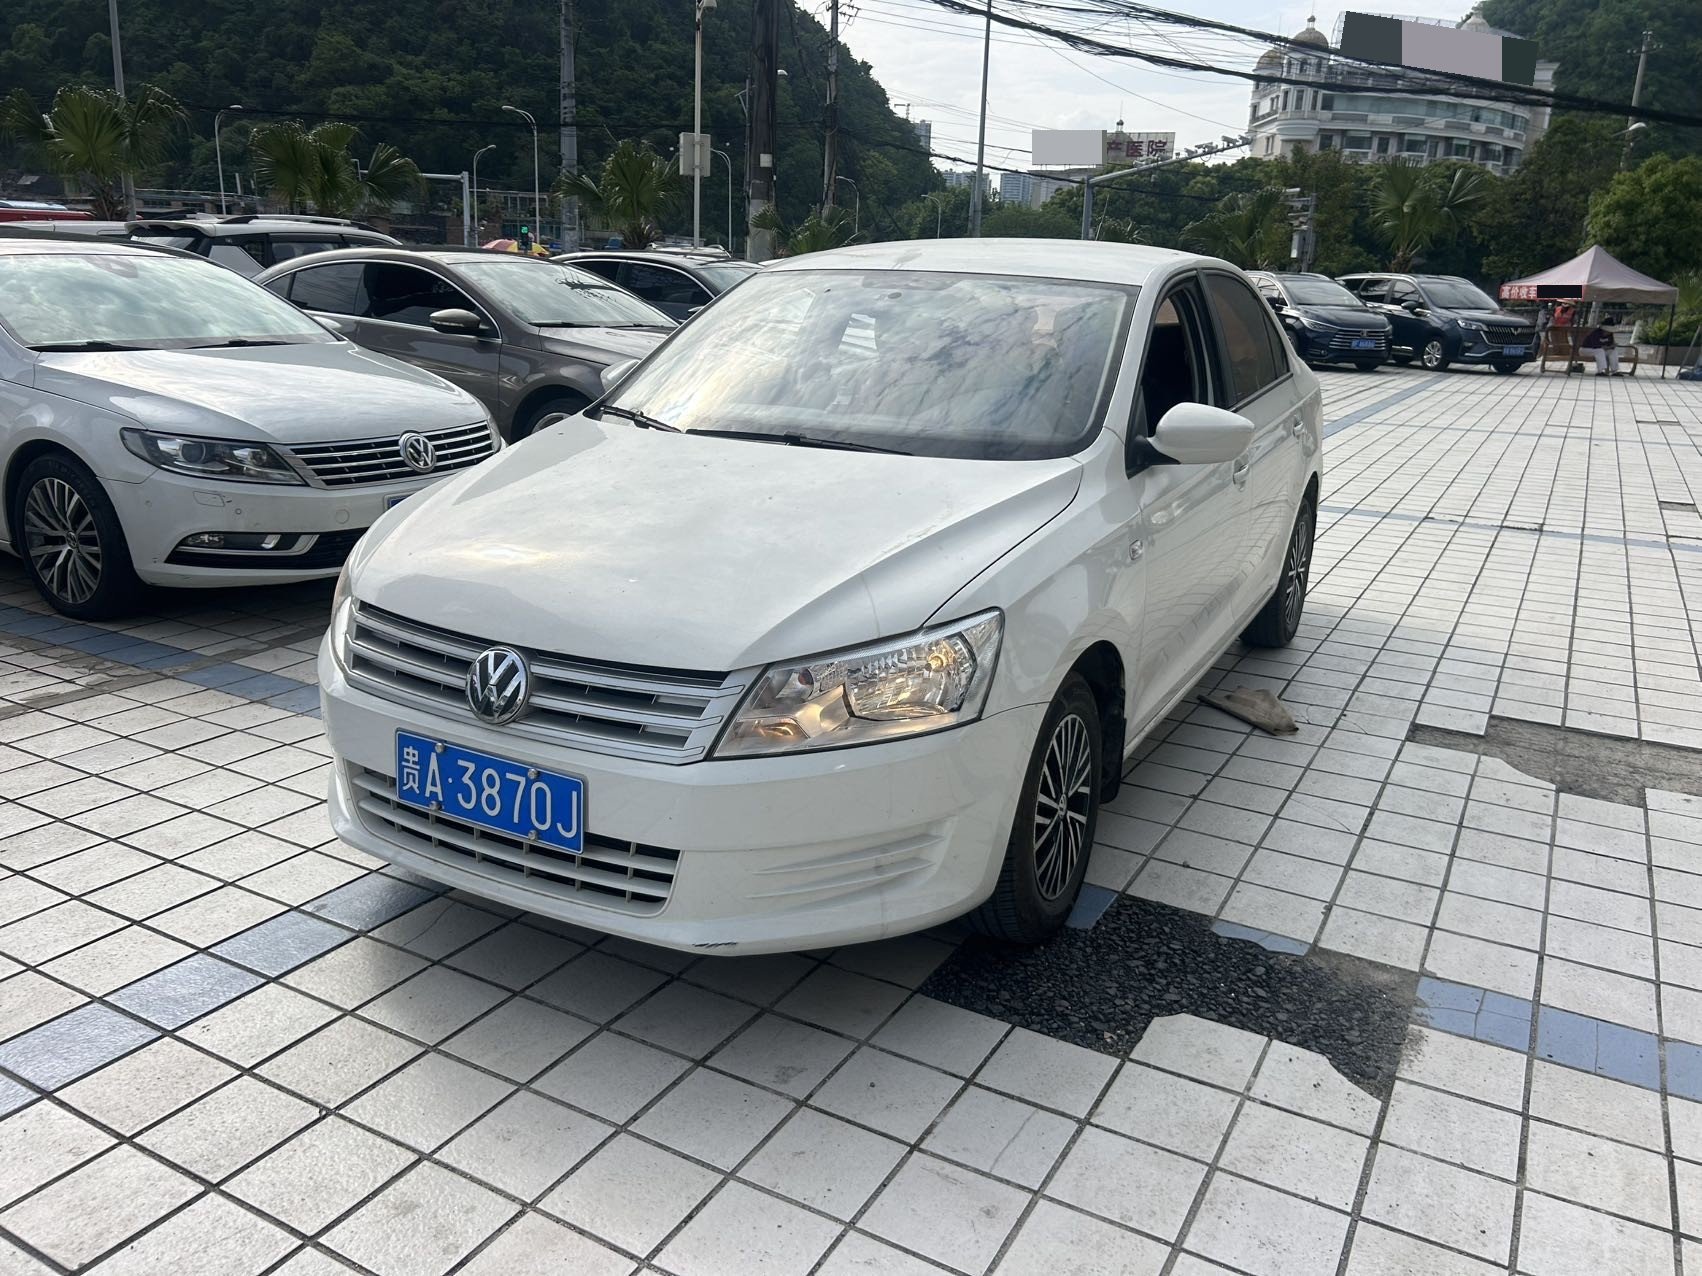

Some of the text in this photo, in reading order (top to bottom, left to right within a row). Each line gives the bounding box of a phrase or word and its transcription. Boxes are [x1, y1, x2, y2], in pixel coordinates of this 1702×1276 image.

[1501, 286, 1537, 299] 高价收车
[472, 650, 525, 720] VW
[402, 746, 578, 838] 贵A·3870J
